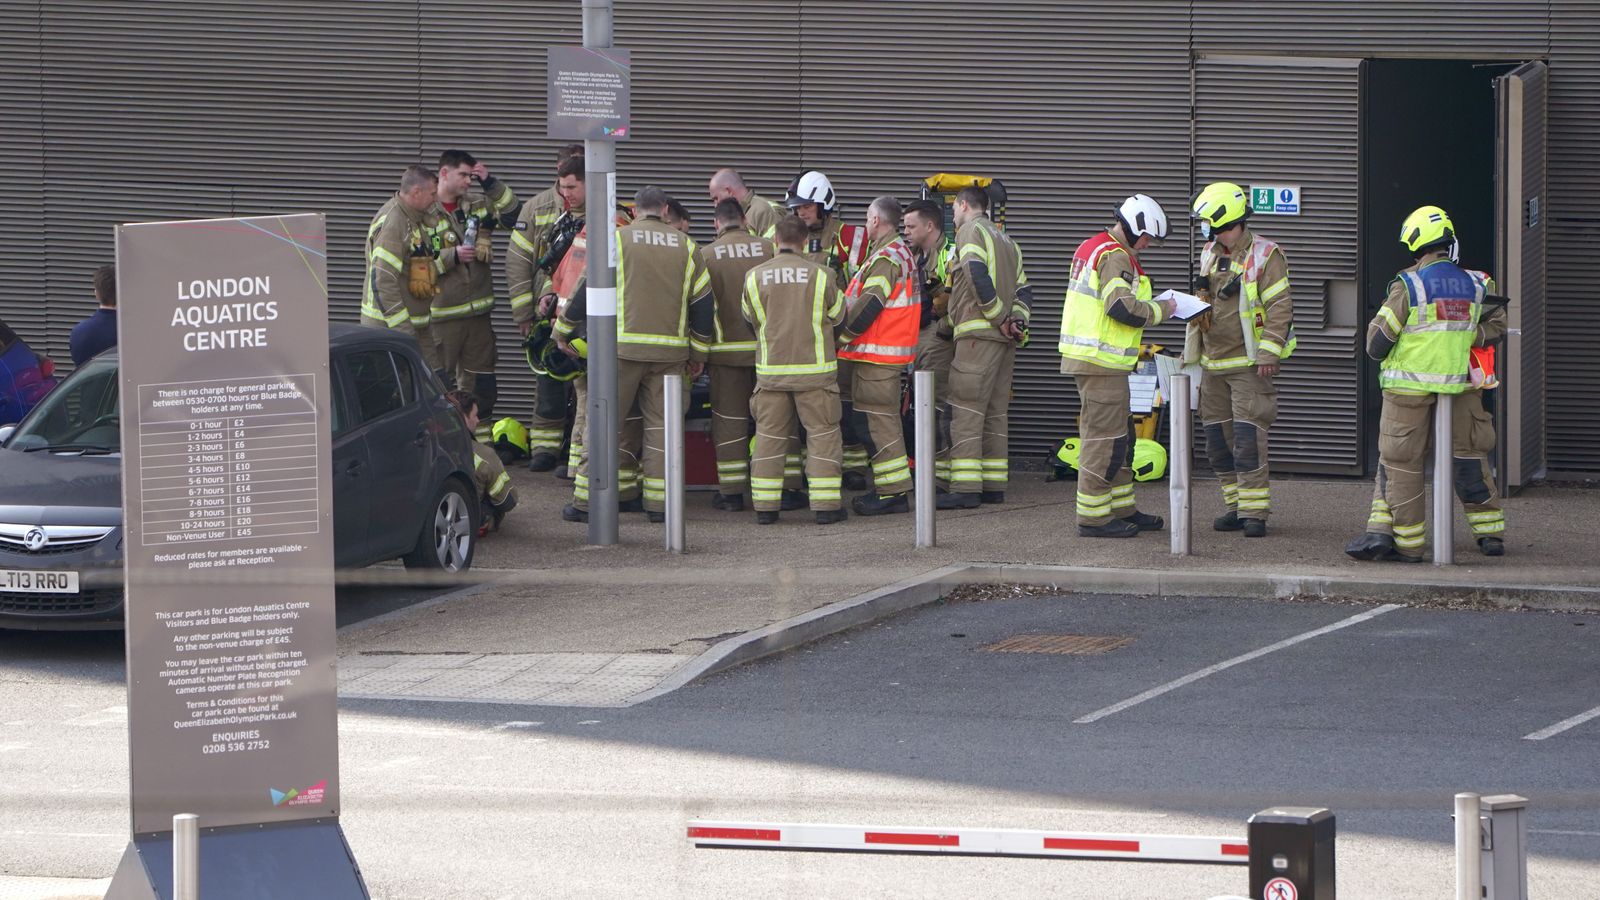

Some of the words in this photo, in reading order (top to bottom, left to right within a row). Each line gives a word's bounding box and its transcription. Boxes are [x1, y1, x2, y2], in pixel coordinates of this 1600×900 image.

[632, 230, 679, 247] FIRE
[714, 242, 763, 260] FIRE
[762, 267, 809, 285] FIRE
[177, 276, 270, 300] LONDON
[1429, 278, 1470, 295] FIRE
[171, 301, 278, 328] AQUATICS
[183, 328, 267, 351] CENTRE
[188, 389, 199, 398] no
[200, 388, 224, 397] charge
[226, 386, 237, 396] for
[239, 384, 266, 393] general
[267, 383, 296, 393] parking
[186, 396, 227, 406] 0530-0700
[228, 395, 250, 404] hours
[278, 391, 302, 400] Badge
[190, 422, 203, 430] 0-1
[205, 421, 222, 430] hour
[234, 419, 244, 428] £2
[188, 433, 200, 442] 1-2
[201, 433, 222, 441] hours
[234, 430, 244, 439] £4
[188, 444, 200, 452] 2-3
[202, 444, 223, 452] hours
[235, 441, 245, 450] £6
[235, 452, 245, 461] £8
[236, 463, 250, 471] £10
[188, 477, 201, 485] 5-6
[203, 477, 224, 485] hours
[236, 474, 250, 483] £12
[189, 488, 202, 496] 6-7
[203, 488, 224, 496] hours
[236, 485, 250, 493] £14
[189, 499, 202, 507] 7-8
[203, 499, 224, 507] hours
[237, 496, 251, 504] £16
[189, 510, 202, 518] 8-9
[204, 510, 225, 518] hours
[237, 507, 251, 515] £18
[181, 521, 202, 529] 10-24
[237, 518, 252, 526] £20
[166, 533, 207, 541] Non-Venue
[208, 531, 225, 540] User
[237, 528, 252, 537] £45
[154, 553, 186, 561] Reduced
[220, 549, 254, 557] members
[255, 548, 268, 557] are
[269, 545, 302, 553] available
[188, 561, 212, 569] please
[0, 572, 31, 588] T13
[36, 573, 68, 589] RRO
[185, 610, 202, 618] park
[253, 604, 284, 612] Aquatics
[165, 618, 194, 627] Visitors
[229, 615, 252, 623] Badge
[253, 613, 280, 621] holders
[281, 611, 299, 619] only.
[211, 632, 240, 640] parking
[267, 627, 293, 637] subject
[185, 642, 198, 651] the
[199, 641, 238, 649] non-venue
[265, 637, 273, 645] of
[274, 636, 291, 644] £45.
[247, 653, 264, 662] park
[265, 652, 289, 660] within
[159, 669, 189, 677] minutes
[190, 666, 198, 675] of
[200, 665, 224, 674] arrival
[226, 664, 254, 672] without
[256, 662, 276, 670] being
[277, 659, 308, 670] charged.
[168, 676, 206, 685] Automatic
[238, 673, 257, 681] Plate
[258, 670, 300, 678] Recognition
[176, 686, 207, 694] cameras
[207, 684, 236, 692] operate
[246, 681, 260, 689] this
[274, 679, 293, 687] park.
[217, 697, 256, 706] Conditions
[257, 696, 269, 705] for
[269, 695, 284, 704] this
[205, 709, 222, 717] park
[223, 708, 236, 717] can
[248, 704, 269, 715] found
[271, 704, 278, 714] at
[174, 713, 297, 728] QueenElizabethOlympicPark.co.uk
[212, 730, 260, 743] ENQUIRIES
[203, 744, 225, 753] 0208
[228, 742, 245, 751] 536
[247, 740, 269, 750] 2752
